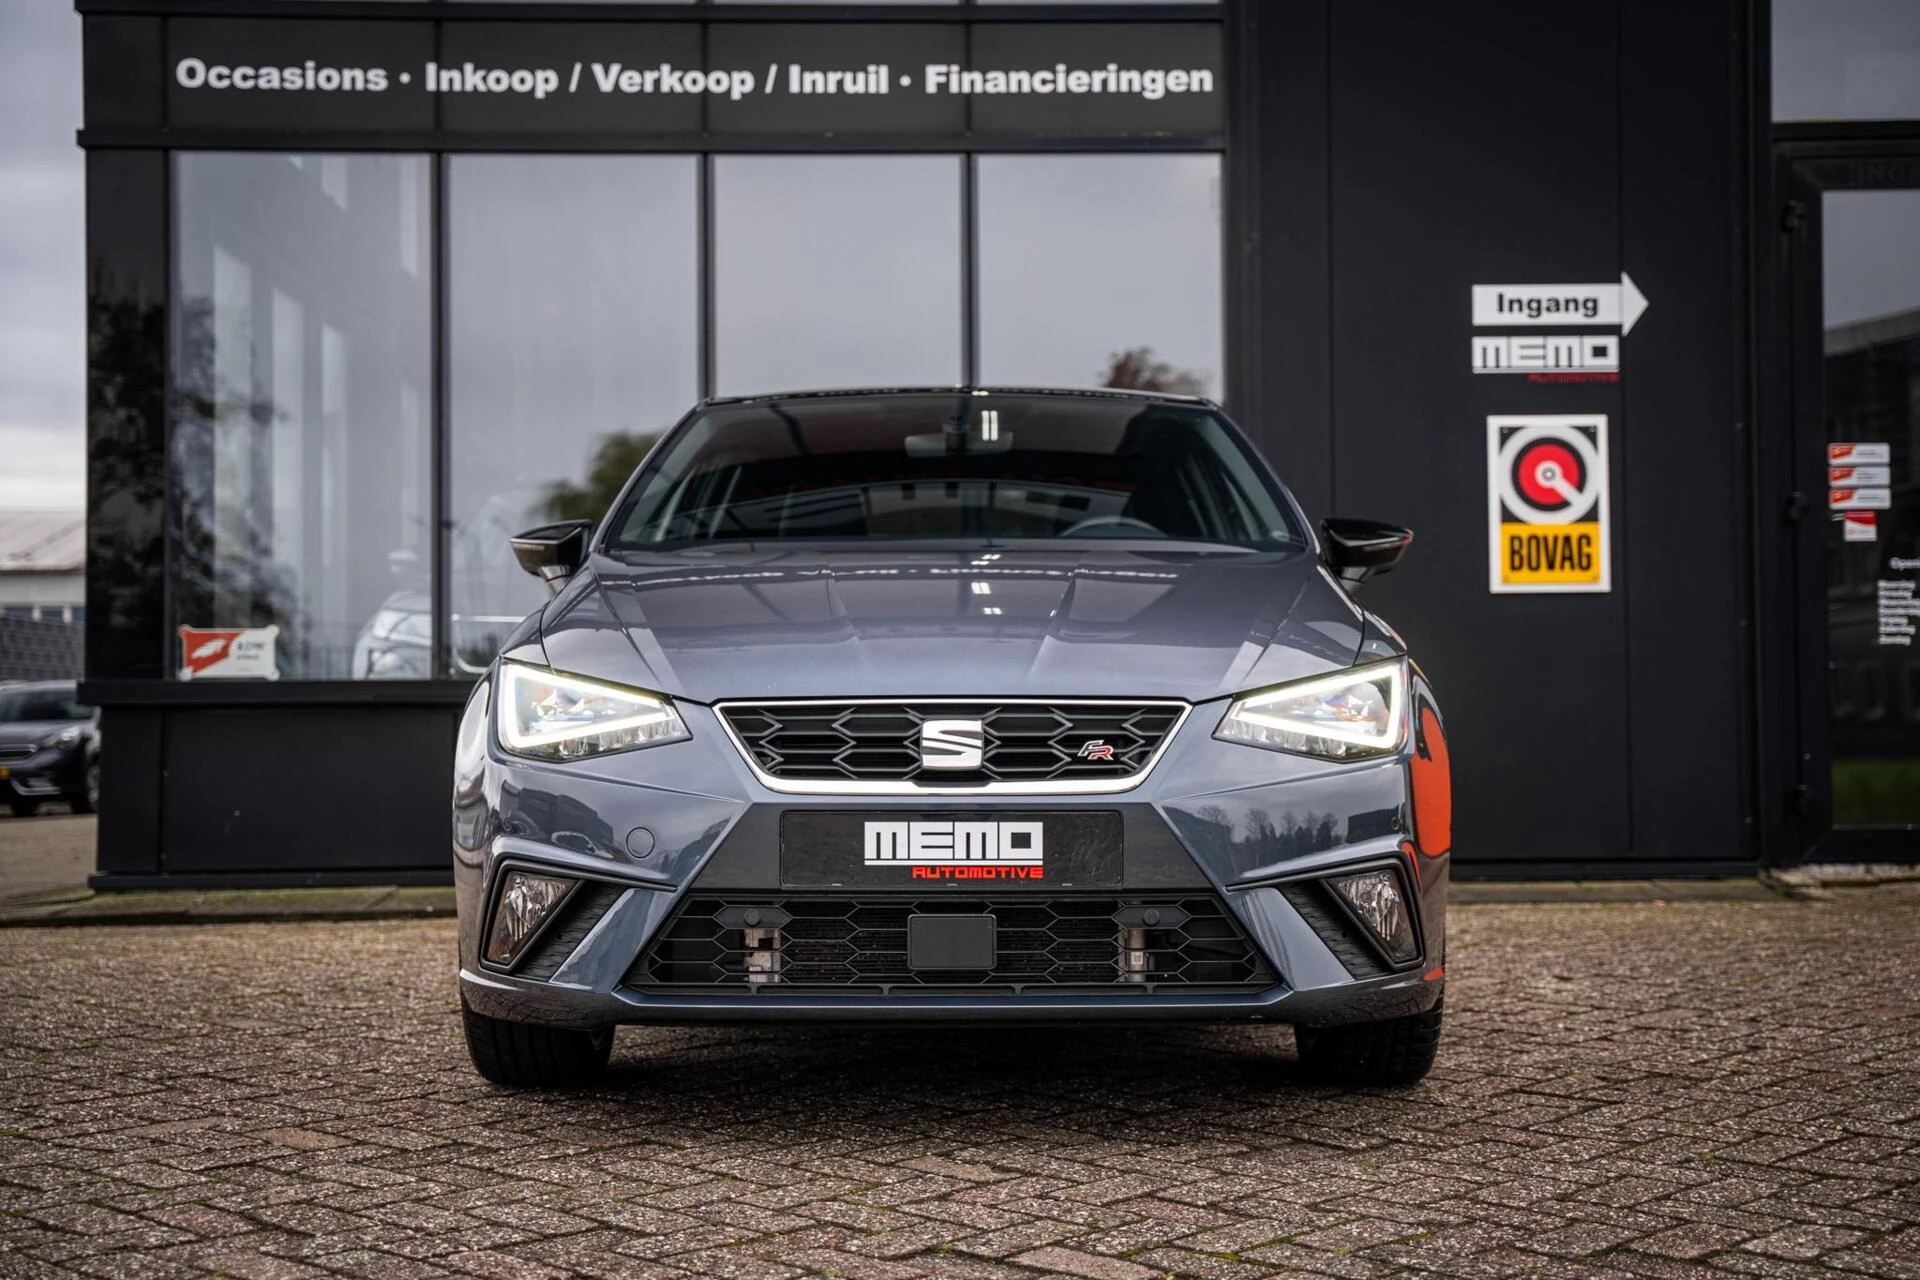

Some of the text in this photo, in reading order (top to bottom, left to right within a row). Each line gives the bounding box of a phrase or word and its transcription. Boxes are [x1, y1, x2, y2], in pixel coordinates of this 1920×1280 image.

[176, 58, 388, 92] Occasions
[425, 62, 559, 99] Inkoop
[591, 63, 755, 101] Verkoop
[788, 64, 890, 96] Inruil
[925, 63, 1214, 100] Financieringen
[1497, 293, 1599, 319] Ingang
[1472, 335, 1619, 370] MEMO
[1509, 534, 1592, 572] BOVAG
[1077, 740, 1114, 760] FR
[864, 821, 1044, 860] MEMO
[912, 865, 1044, 880] AUTOMOTIVE
